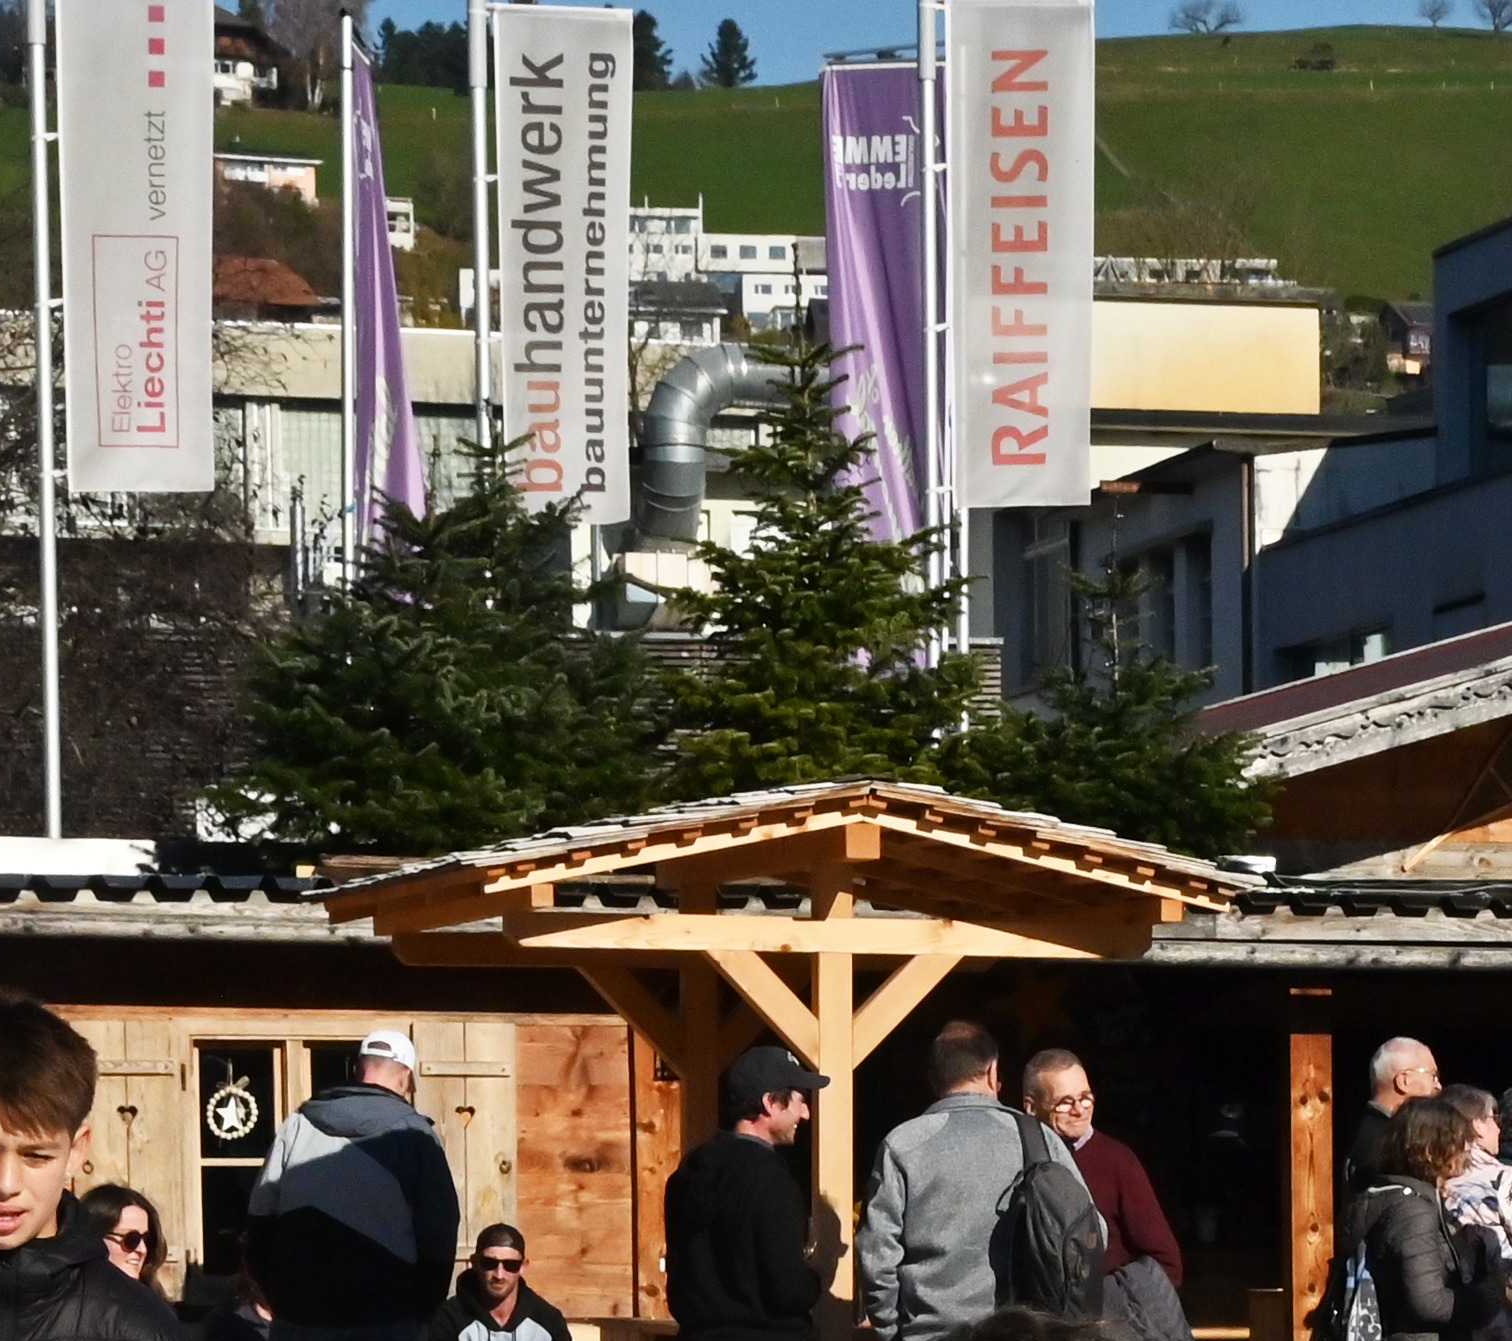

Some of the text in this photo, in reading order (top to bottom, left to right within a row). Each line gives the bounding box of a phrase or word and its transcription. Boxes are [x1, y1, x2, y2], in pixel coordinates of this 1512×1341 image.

[143, 110, 167, 222] vernetzt
[508, 52, 566, 493] bauhandwerk
[578, 51, 617, 494] bauunternehmung
[989, 50, 1050, 466] RAIFFEISEN
[111, 343, 133, 433] Elektro
[136, 249, 167, 434] Liechti AG
